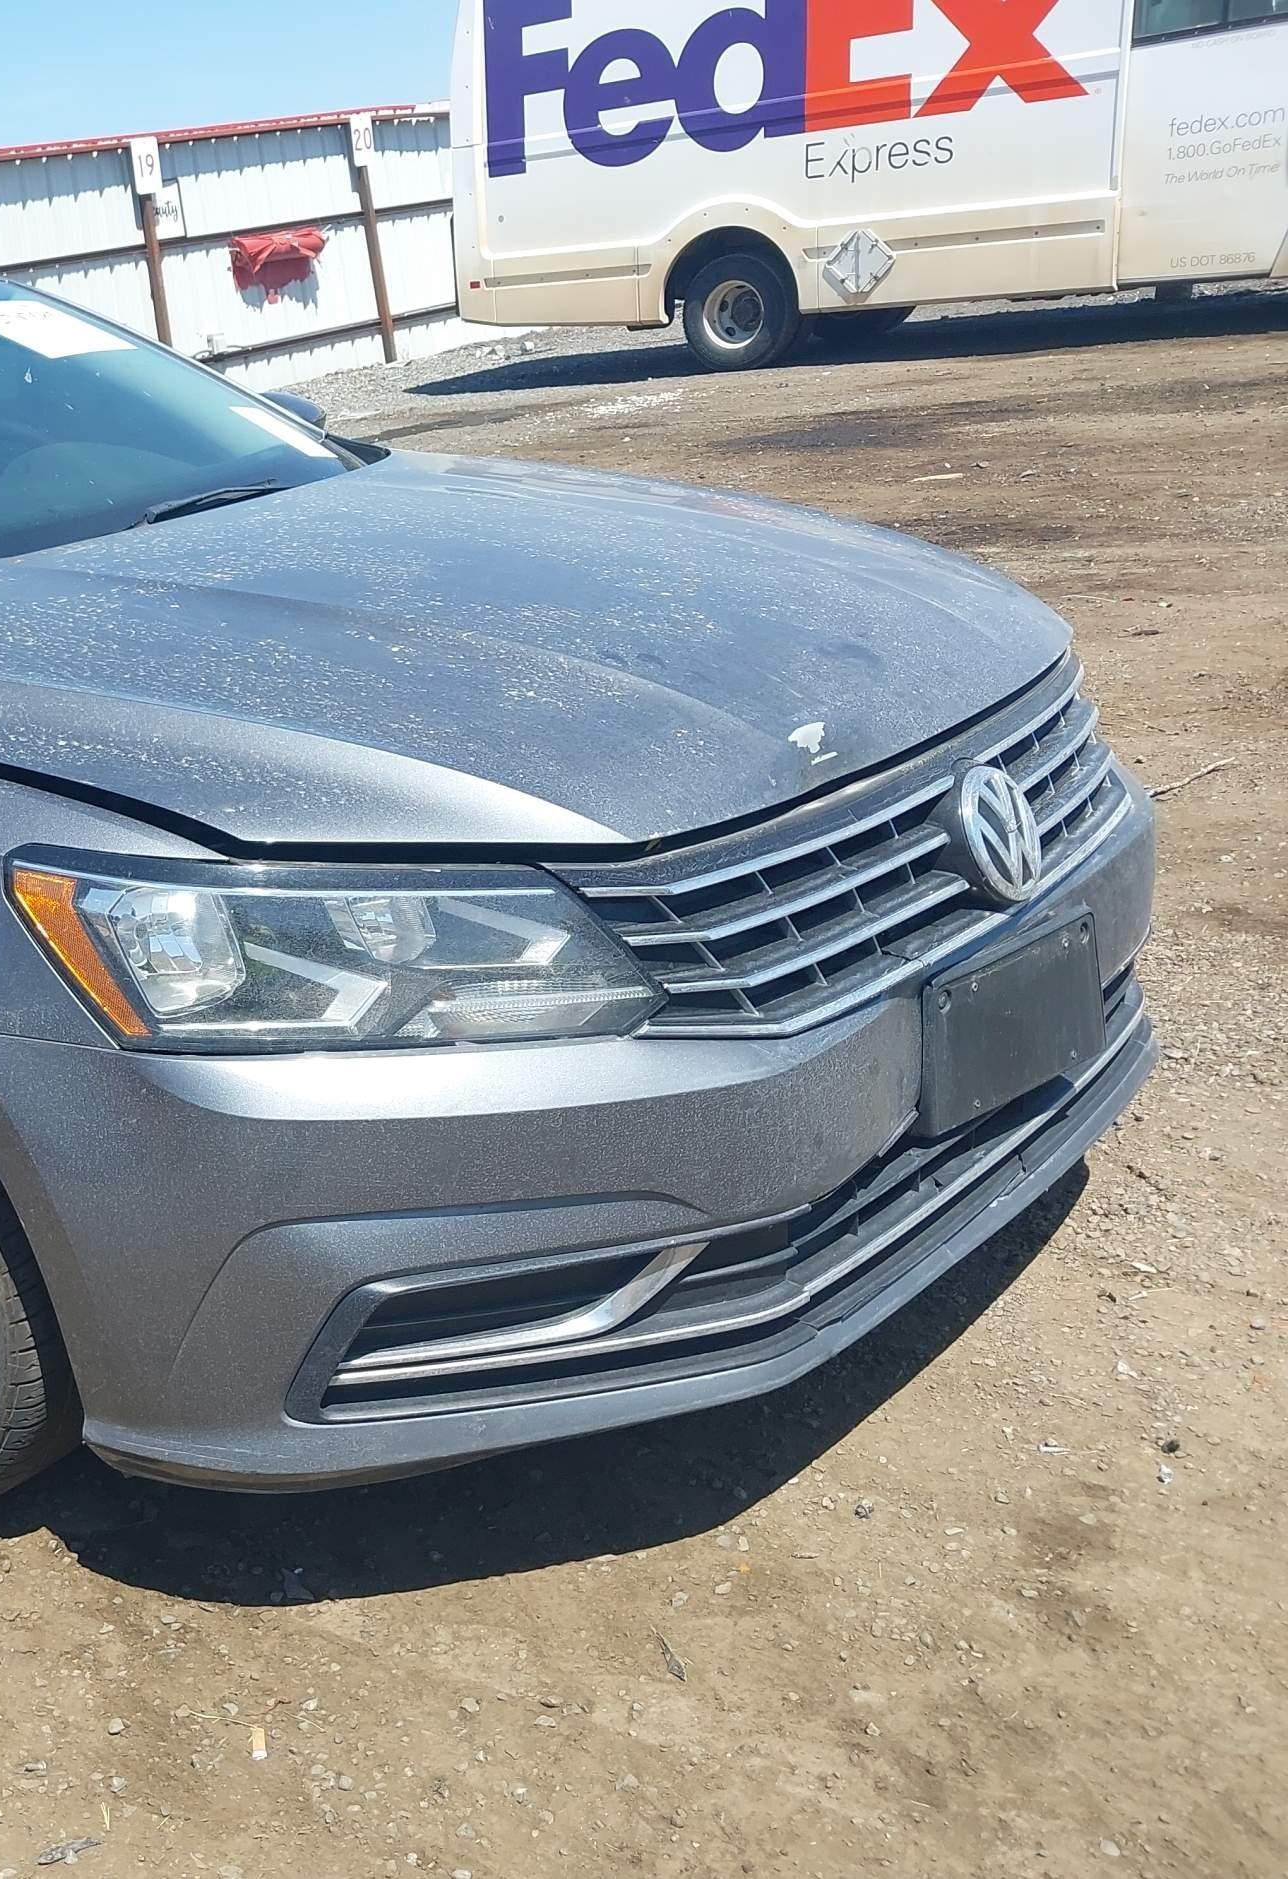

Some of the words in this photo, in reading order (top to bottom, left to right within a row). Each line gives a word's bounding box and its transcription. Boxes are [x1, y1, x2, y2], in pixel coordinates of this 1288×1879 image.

[483, 0, 1089, 178] FedEx
[1168, 107, 1285, 137] fedex.com
[353, 127, 372, 151] 20
[1167, 133, 1282, 160] 1.800.GoFedEx
[138, 153, 154, 177] 19
[805, 136, 954, 183] Express
[1164, 173, 1185, 184] The
[1187, 168, 1224, 183] World
[1226, 165, 1245, 178] On
[1248, 162, 1280, 177] Time
[1170, 255, 1187, 269] US
[1190, 254, 1216, 267] DOT
